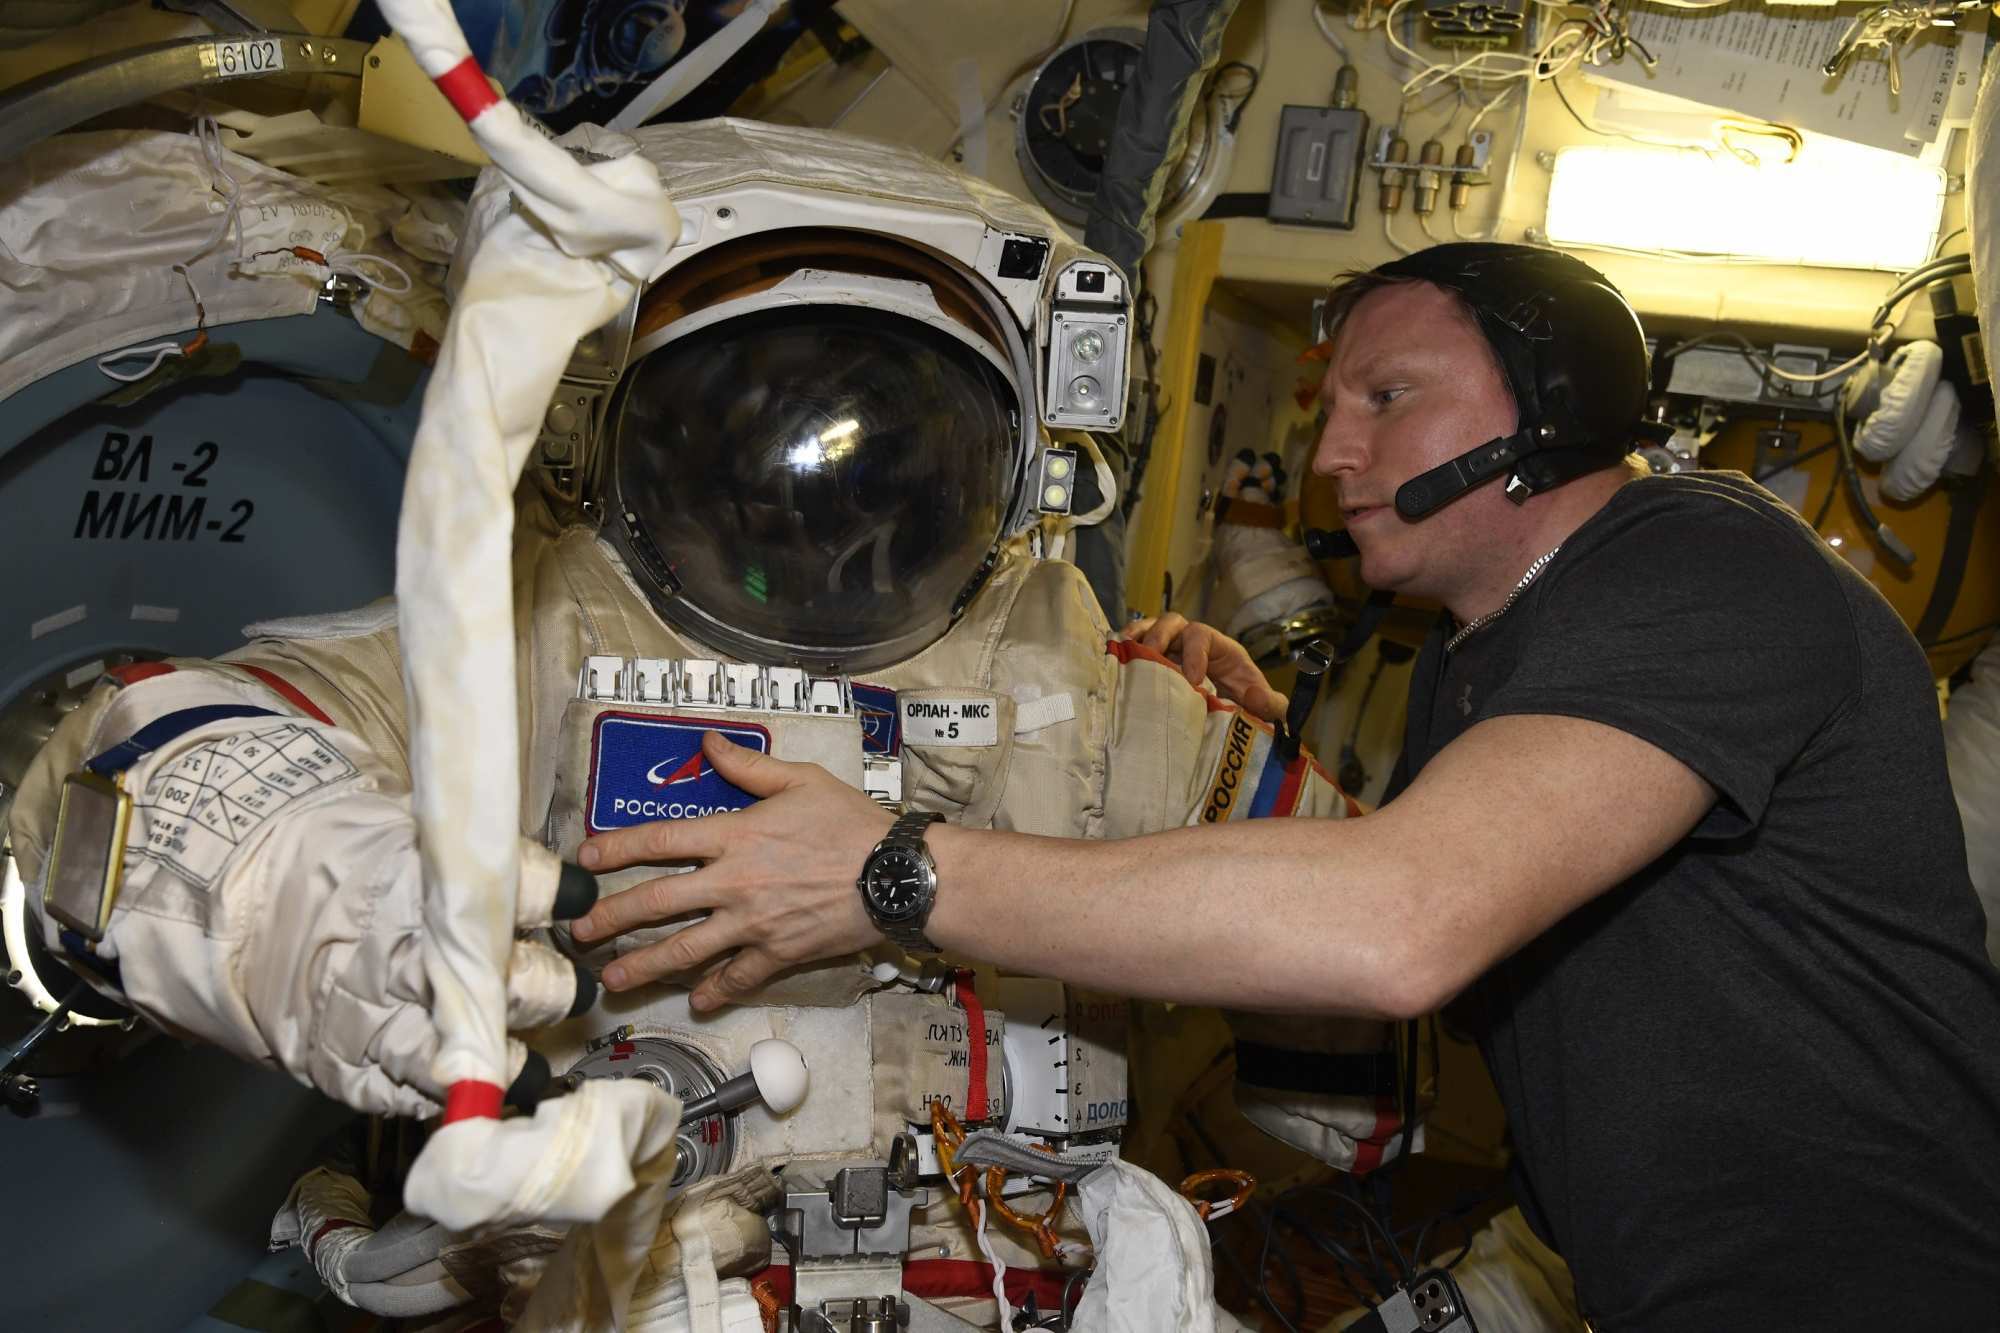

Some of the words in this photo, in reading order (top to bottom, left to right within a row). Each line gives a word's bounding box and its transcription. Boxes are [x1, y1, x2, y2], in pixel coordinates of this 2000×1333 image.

[221, 41, 277, 73] 6102
[92, 432, 153, 483] ВЛ
[171, 441, 219, 488] -2
[73, 489, 255, 544] МИМ-2
[907, 703, 950, 718] ОРЛАН
[961, 703, 990, 718] МКС
[935, 728, 944, 738] №
[947, 722, 959, 739] 5
[1205, 716, 1252, 823] РОССИЯ
[165, 786, 191, 804] 200
